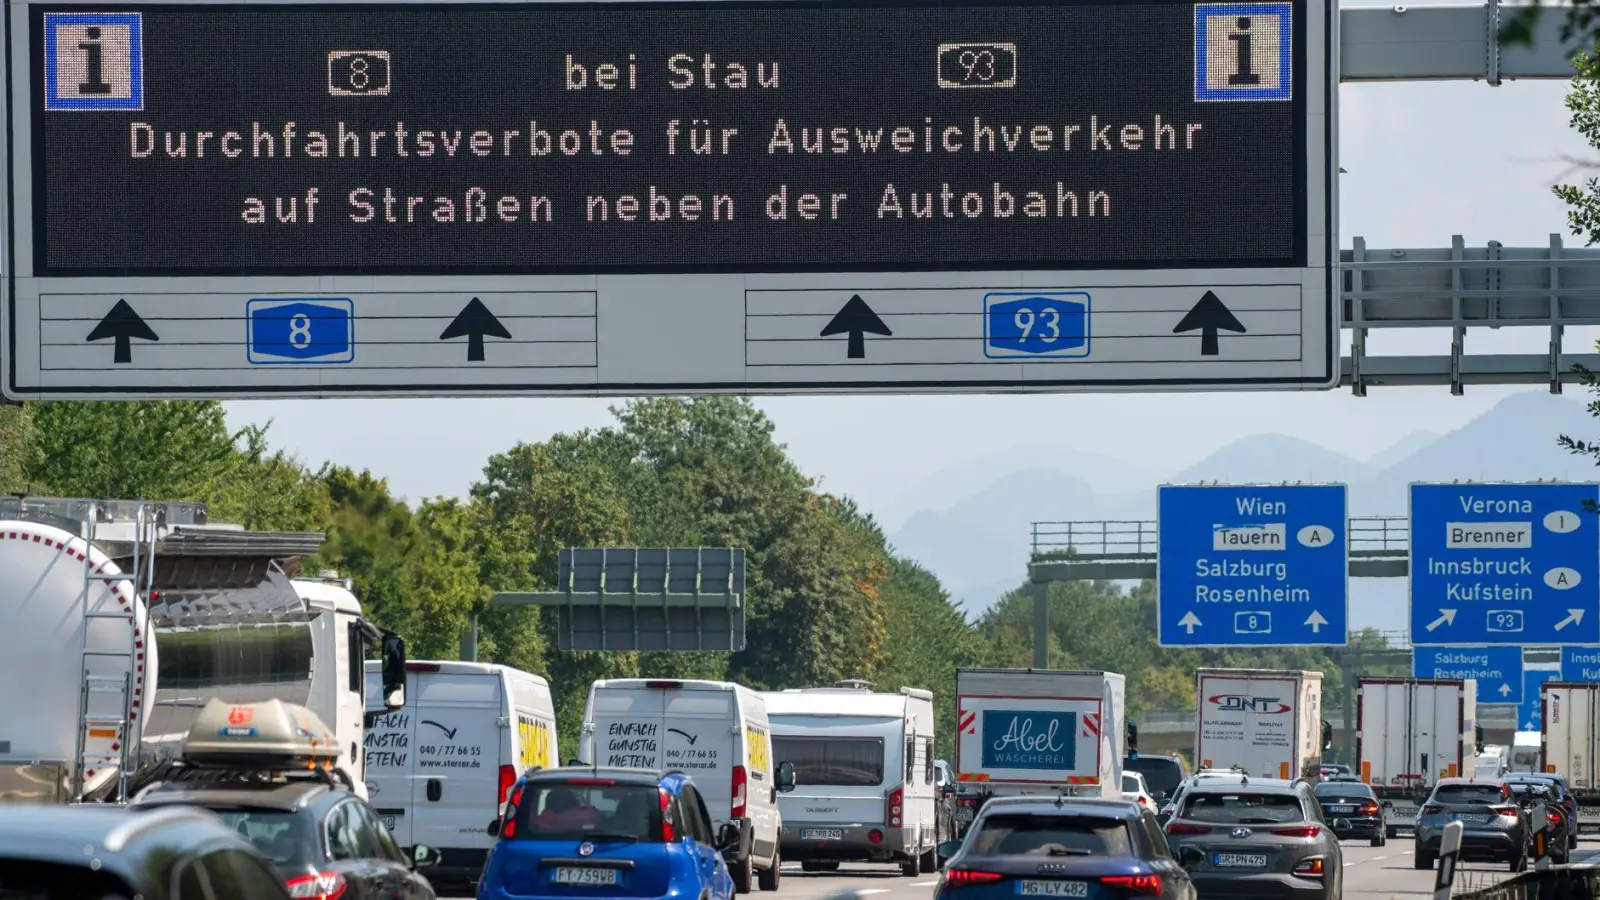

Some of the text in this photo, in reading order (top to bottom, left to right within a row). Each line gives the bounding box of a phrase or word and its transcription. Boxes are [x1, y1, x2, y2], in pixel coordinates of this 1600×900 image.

[566, 53, 780, 90] bei Stau
[959, 51, 994, 80] 93
[350, 58, 369, 90] 8
[130, 115, 1204, 158] Durchfahrtsverbote für Ausweichverkehr
[241, 182, 1111, 224] auf Straßen neben der Autobahn
[290, 313, 311, 349] 8
[1013, 307, 1060, 344] 93
[1236, 498, 1286, 515] Wien
[1460, 496, 1532, 513] Verona
[1220, 529, 1280, 545] Tauern
[1310, 530, 1321, 544] A
[1452, 528, 1525, 544] Brenner
[1196, 559, 1286, 581] Salzburg
[1429, 557, 1532, 576] Innsbruck
[1557, 572, 1568, 586] A
[1196, 584, 1310, 602] Rosenheim
[1446, 583, 1532, 601] Kufstein
[1249, 614, 1257, 629] 8
[1497, 614, 1514, 629] 93
[1435, 653, 1488, 666] Salzburg
[994, 715, 1064, 752] Abel
[420, 745, 436, 756] 040
[445, 745, 456, 756] 77
[458, 746, 468, 756] 66
[470, 746, 481, 757] 55
[666, 750, 680, 758] 040
[687, 750, 696, 758] 77
[697, 750, 707, 759] 66
[708, 750, 718, 759] 55
[994, 752, 1065, 764] WÄSCHEREI
[419, 759, 481, 769] www.starcar.de
[666, 760, 718, 769] www.starcar.de
[1236, 855, 1248, 864] PN
[1249, 855, 1265, 865] 475
[1021, 882, 1086, 895] HG LY 482
